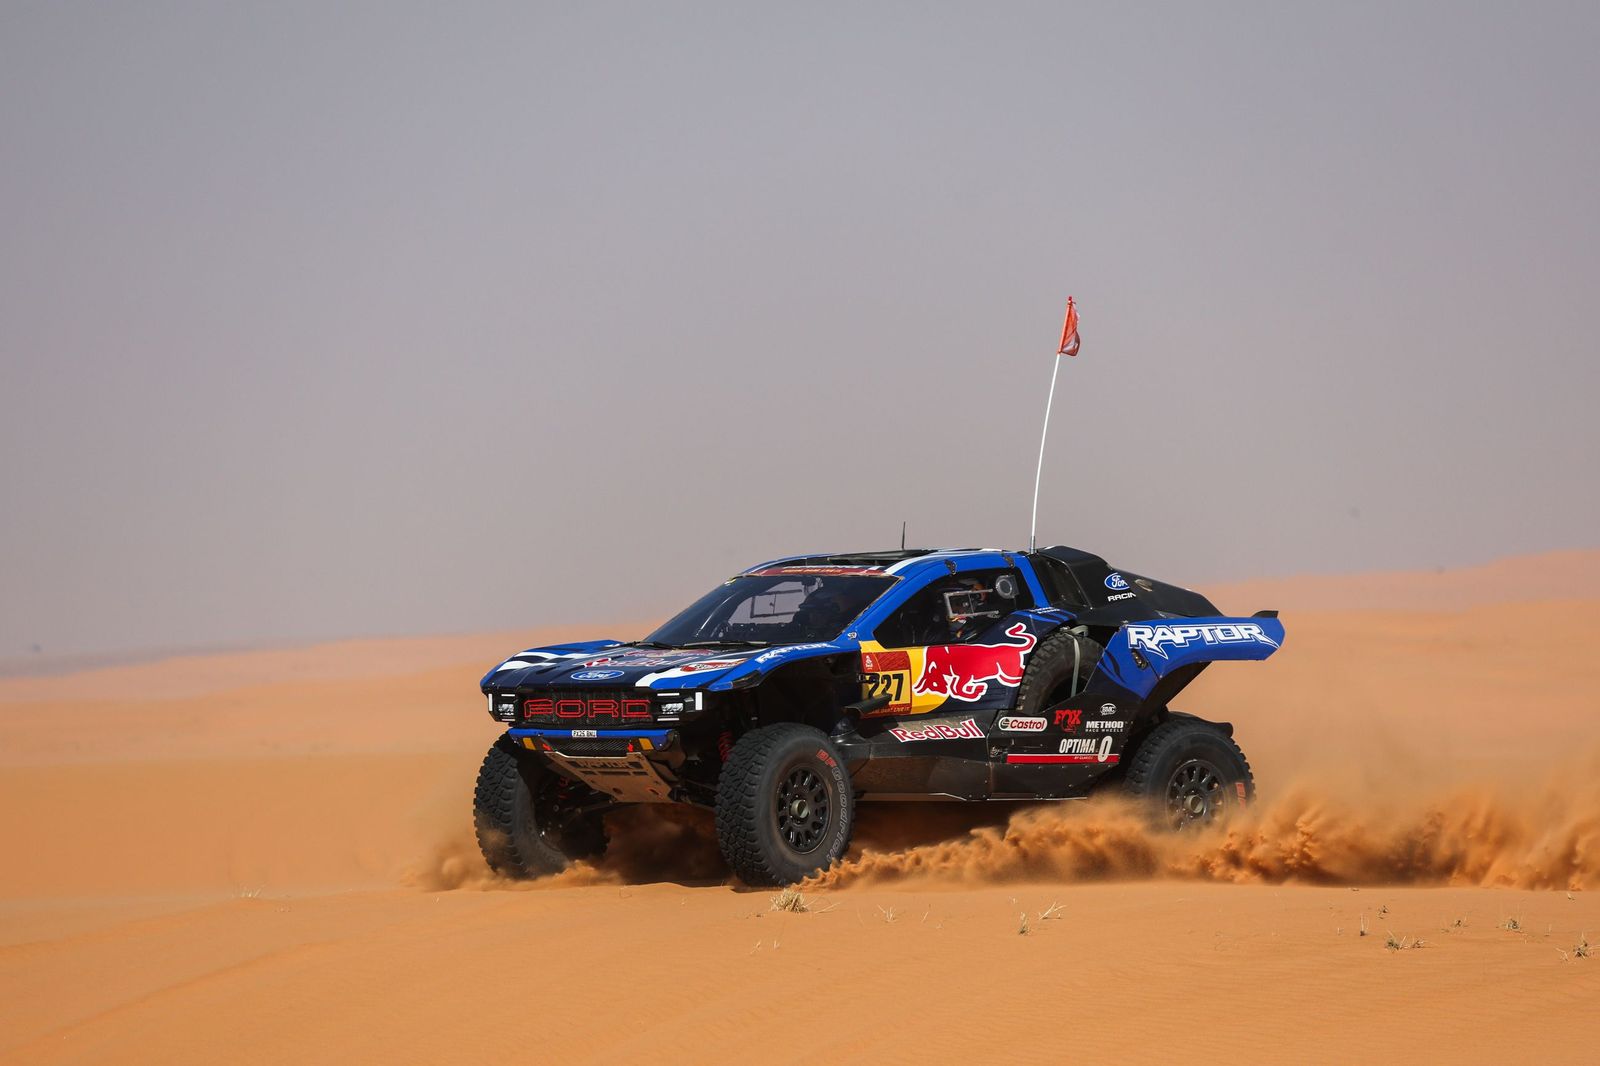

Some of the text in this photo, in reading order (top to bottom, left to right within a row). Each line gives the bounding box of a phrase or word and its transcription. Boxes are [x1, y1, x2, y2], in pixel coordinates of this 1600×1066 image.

[1127, 624, 1280, 660] RAPTOR
[755, 643, 841, 664] RAPTOR
[523, 698, 652, 718] FORD
[1053, 709, 1082, 725] FOX
[889, 718, 985, 742] Red Bull
[1010, 719, 1045, 730] Castrol
[1085, 721, 1124, 729] METHOD
[1059, 738, 1096, 753] OPTIMA
